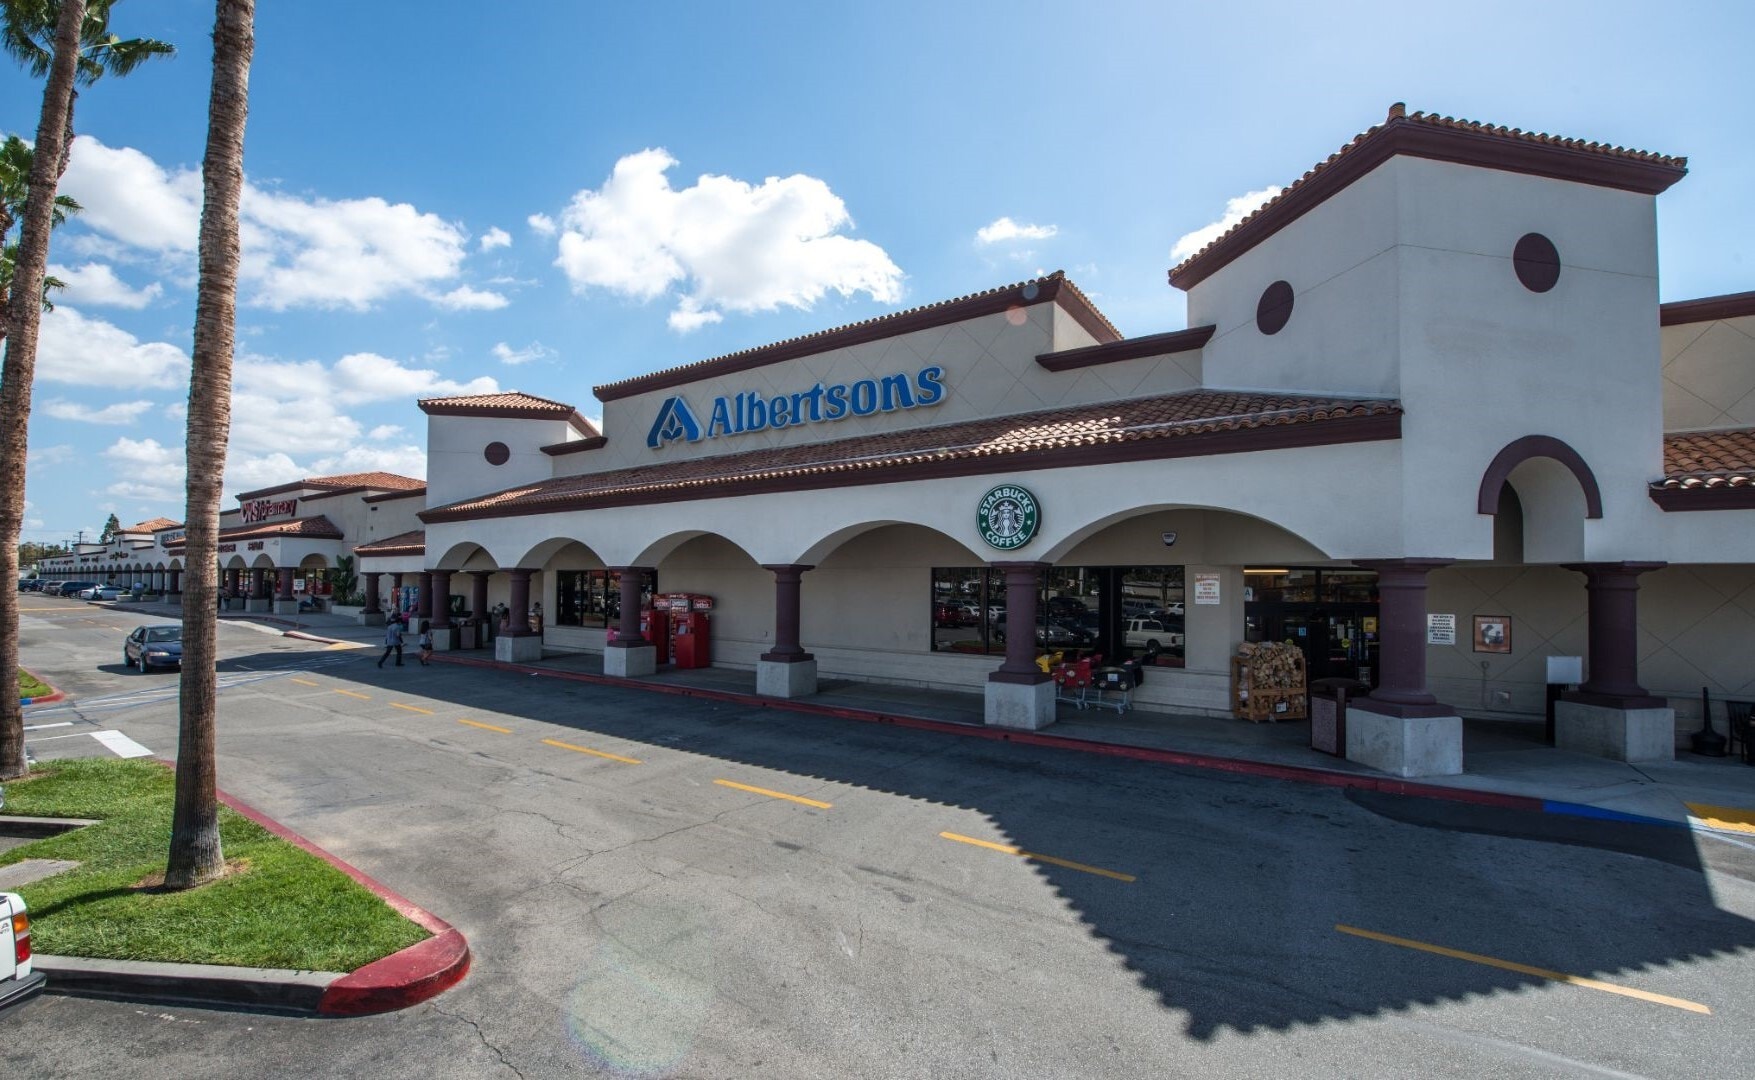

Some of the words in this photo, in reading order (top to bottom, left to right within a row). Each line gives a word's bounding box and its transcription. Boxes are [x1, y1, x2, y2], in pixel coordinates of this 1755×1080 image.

[707, 366, 946, 438] Albertsons
[980, 488, 1034, 516] STARBUCKS
[985, 530, 1026, 547] COFFEE
